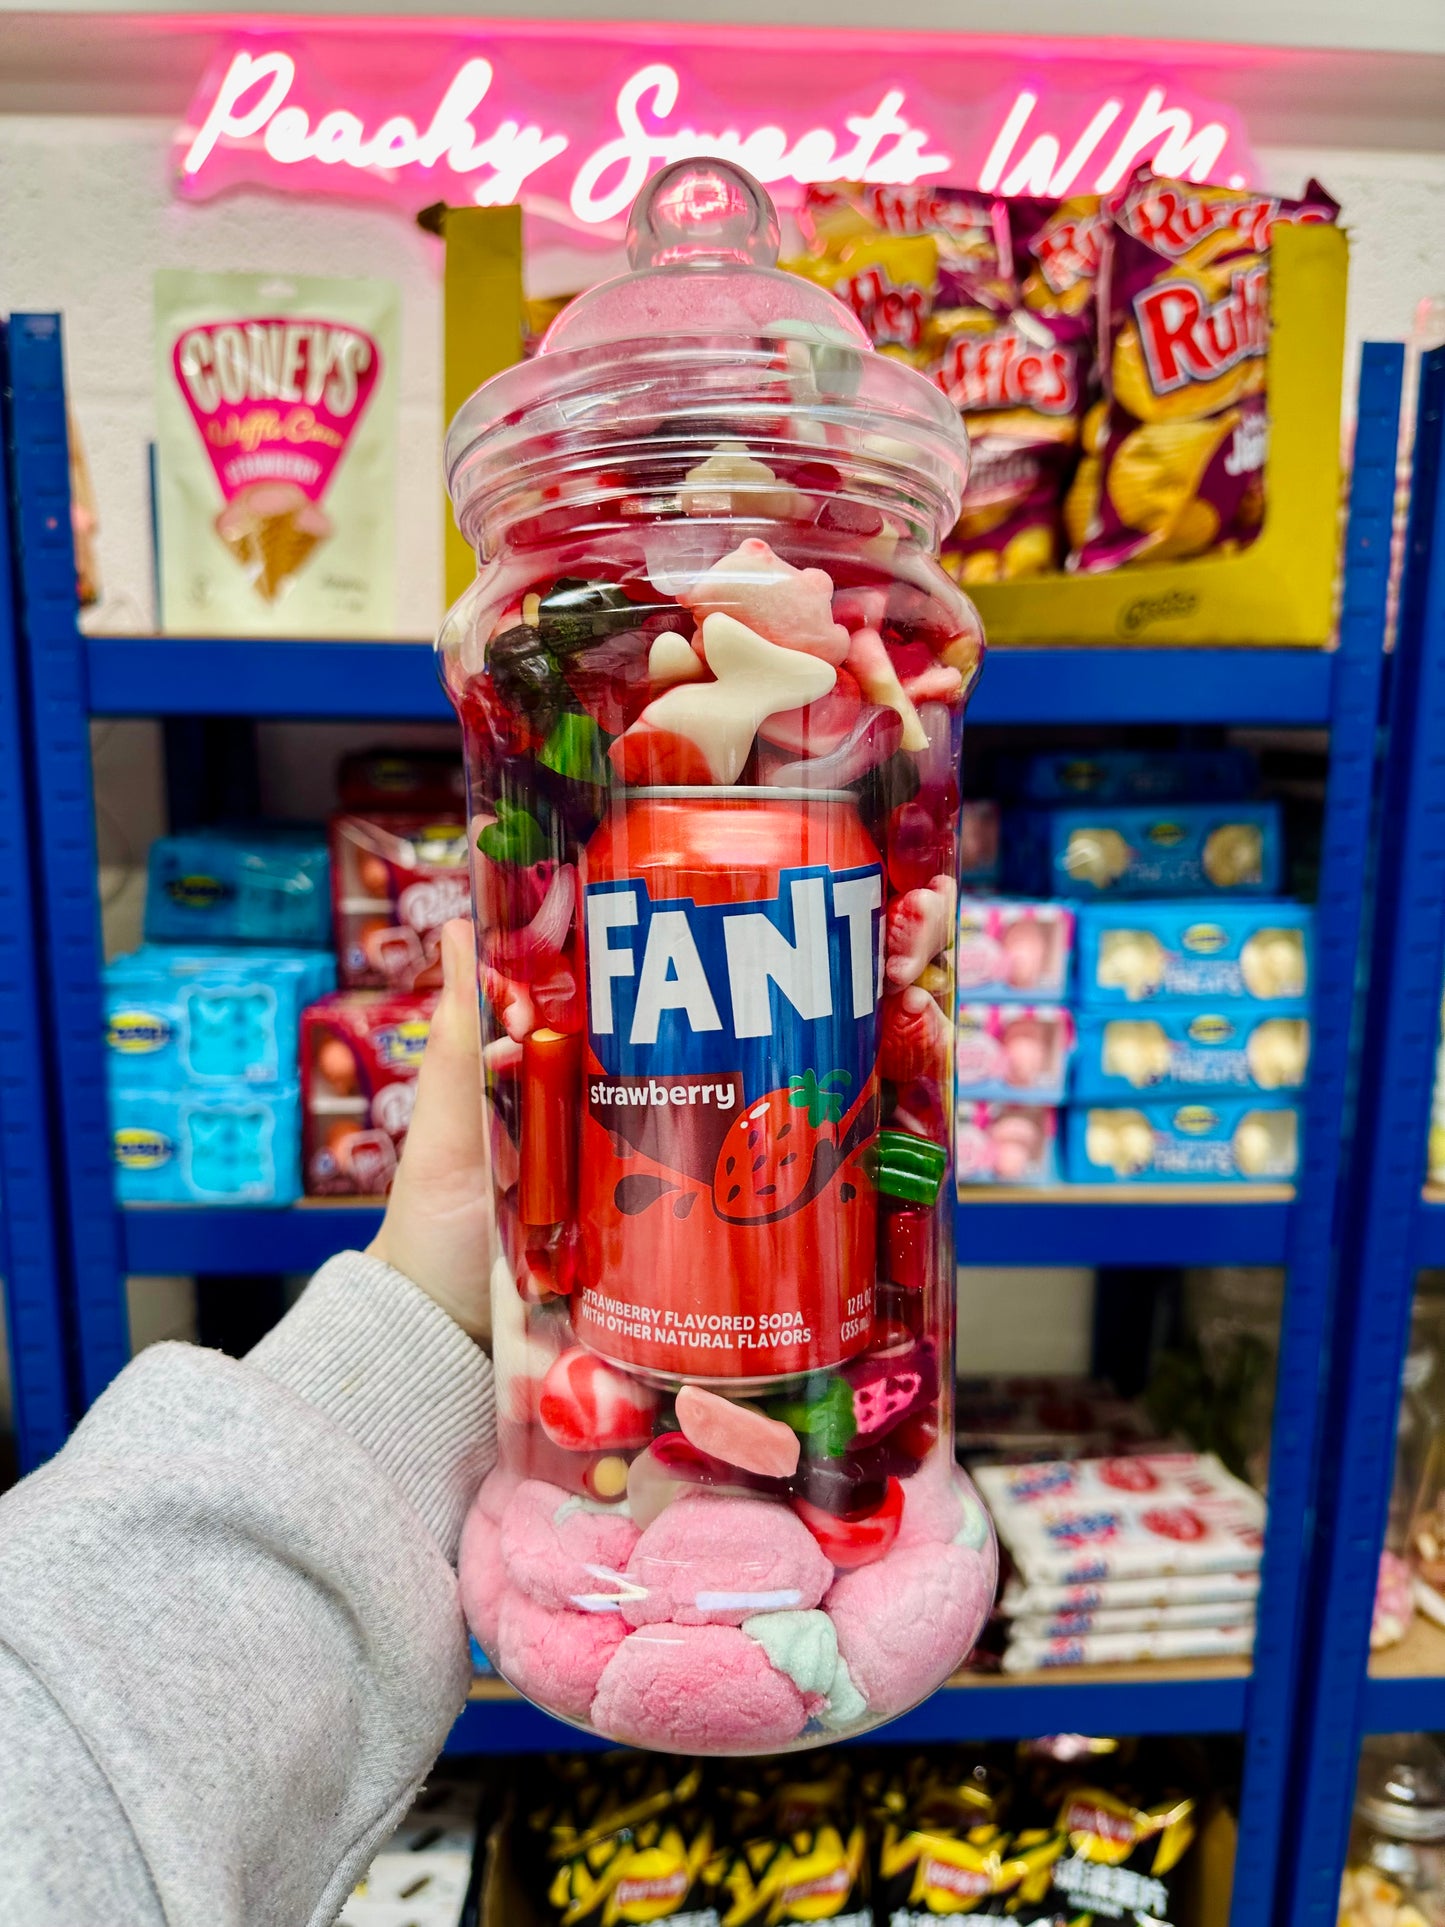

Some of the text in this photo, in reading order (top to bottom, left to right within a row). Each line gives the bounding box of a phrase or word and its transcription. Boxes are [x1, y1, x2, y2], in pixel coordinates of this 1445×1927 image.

[184, 51, 568, 206] Peachy
[570, 63, 951, 223] Sweets
[1134, 266, 1268, 395] Ruff
[587, 873, 886, 1044] FANT
[590, 1079, 736, 1110] strawberry
[581, 1303, 811, 1350] WITH OTHER NATURAL FLAVORS
[582, 1285, 804, 1331] STRAWBERRY FLAVORED SODA
[847, 1297, 856, 1317] 12
